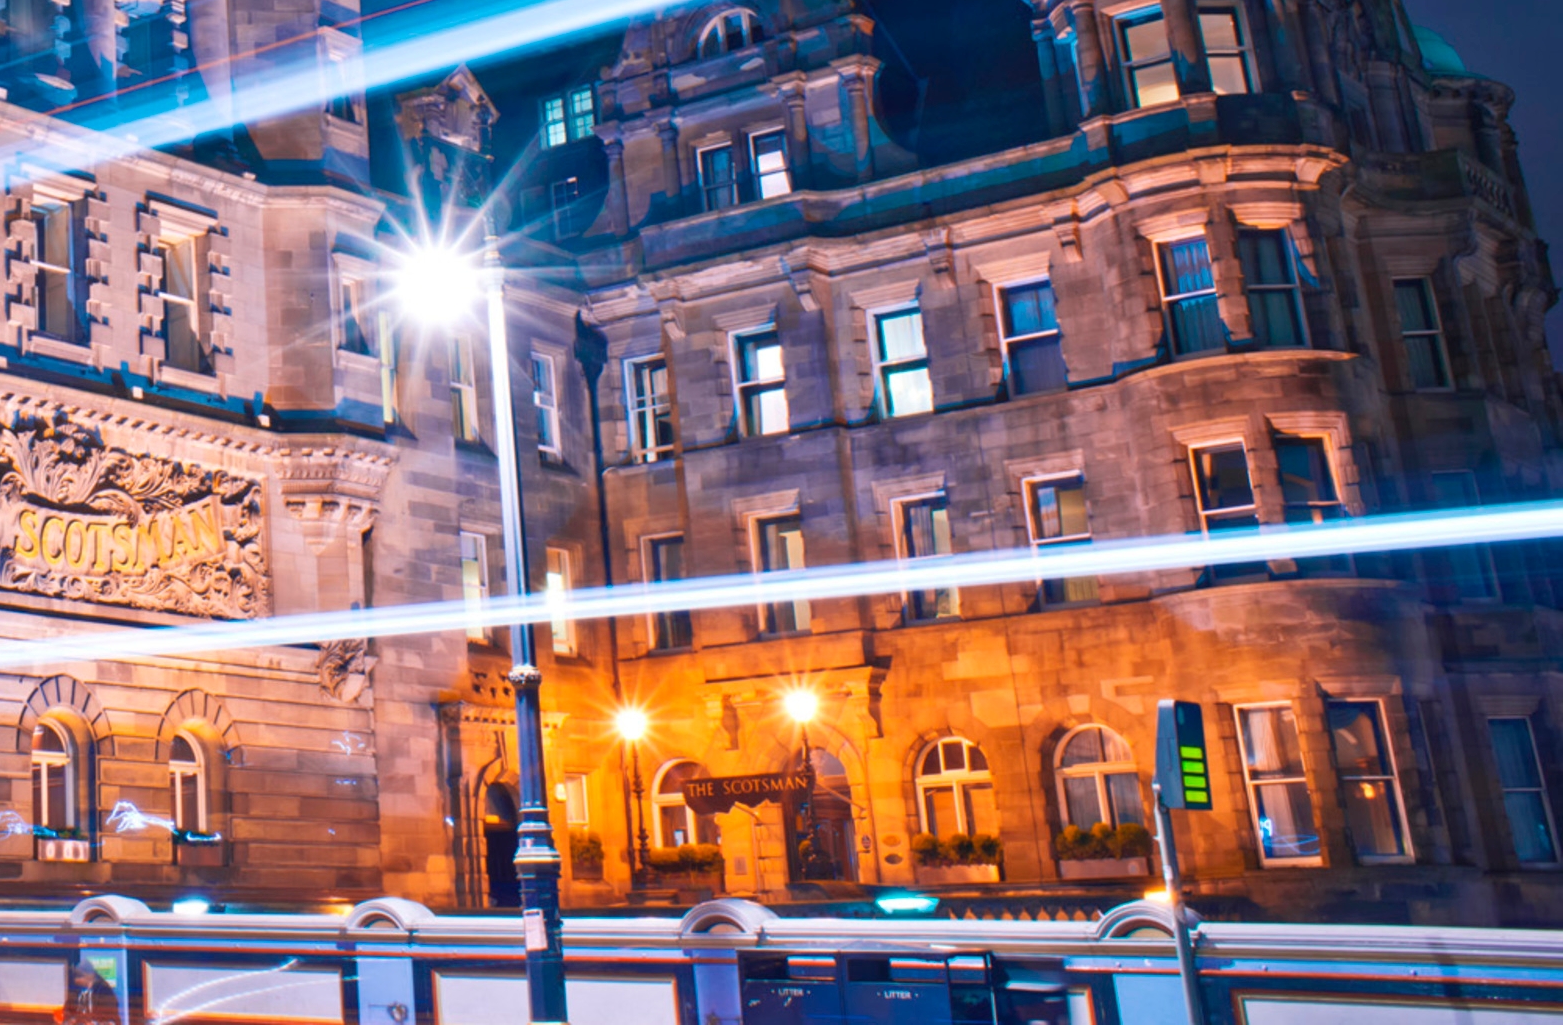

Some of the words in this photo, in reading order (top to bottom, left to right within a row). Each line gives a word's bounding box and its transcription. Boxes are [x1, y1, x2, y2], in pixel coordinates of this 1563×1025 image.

[15, 501, 227, 574] SCOTSMAN
[686, 782, 714, 797] THE
[723, 776, 808, 795] SCOTSMAN
[778, 988, 804, 997] LITTER
[884, 990, 912, 999] LITTER
